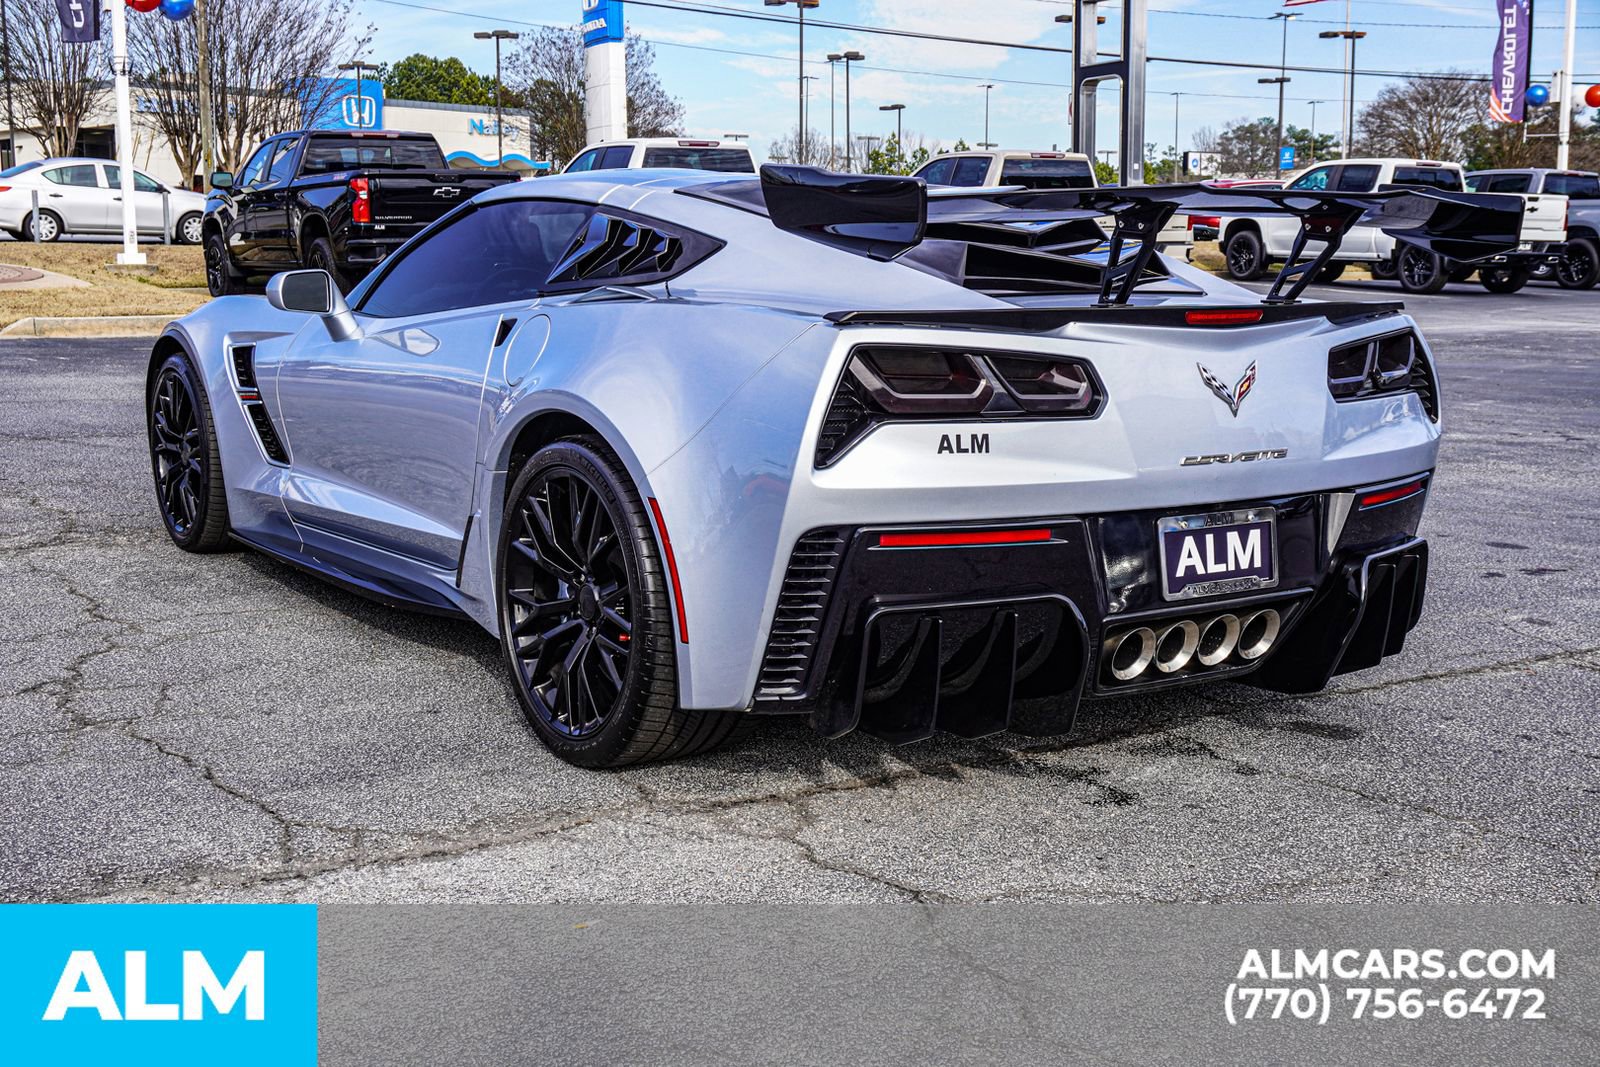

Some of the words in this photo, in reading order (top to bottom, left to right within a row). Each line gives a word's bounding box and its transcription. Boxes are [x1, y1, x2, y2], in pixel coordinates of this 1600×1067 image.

[468, 118, 520, 142] Naley
[937, 433, 990, 454] ALM
[1179, 447, 1288, 466] CORVETTE
[1175, 528, 1262, 577] ALM
